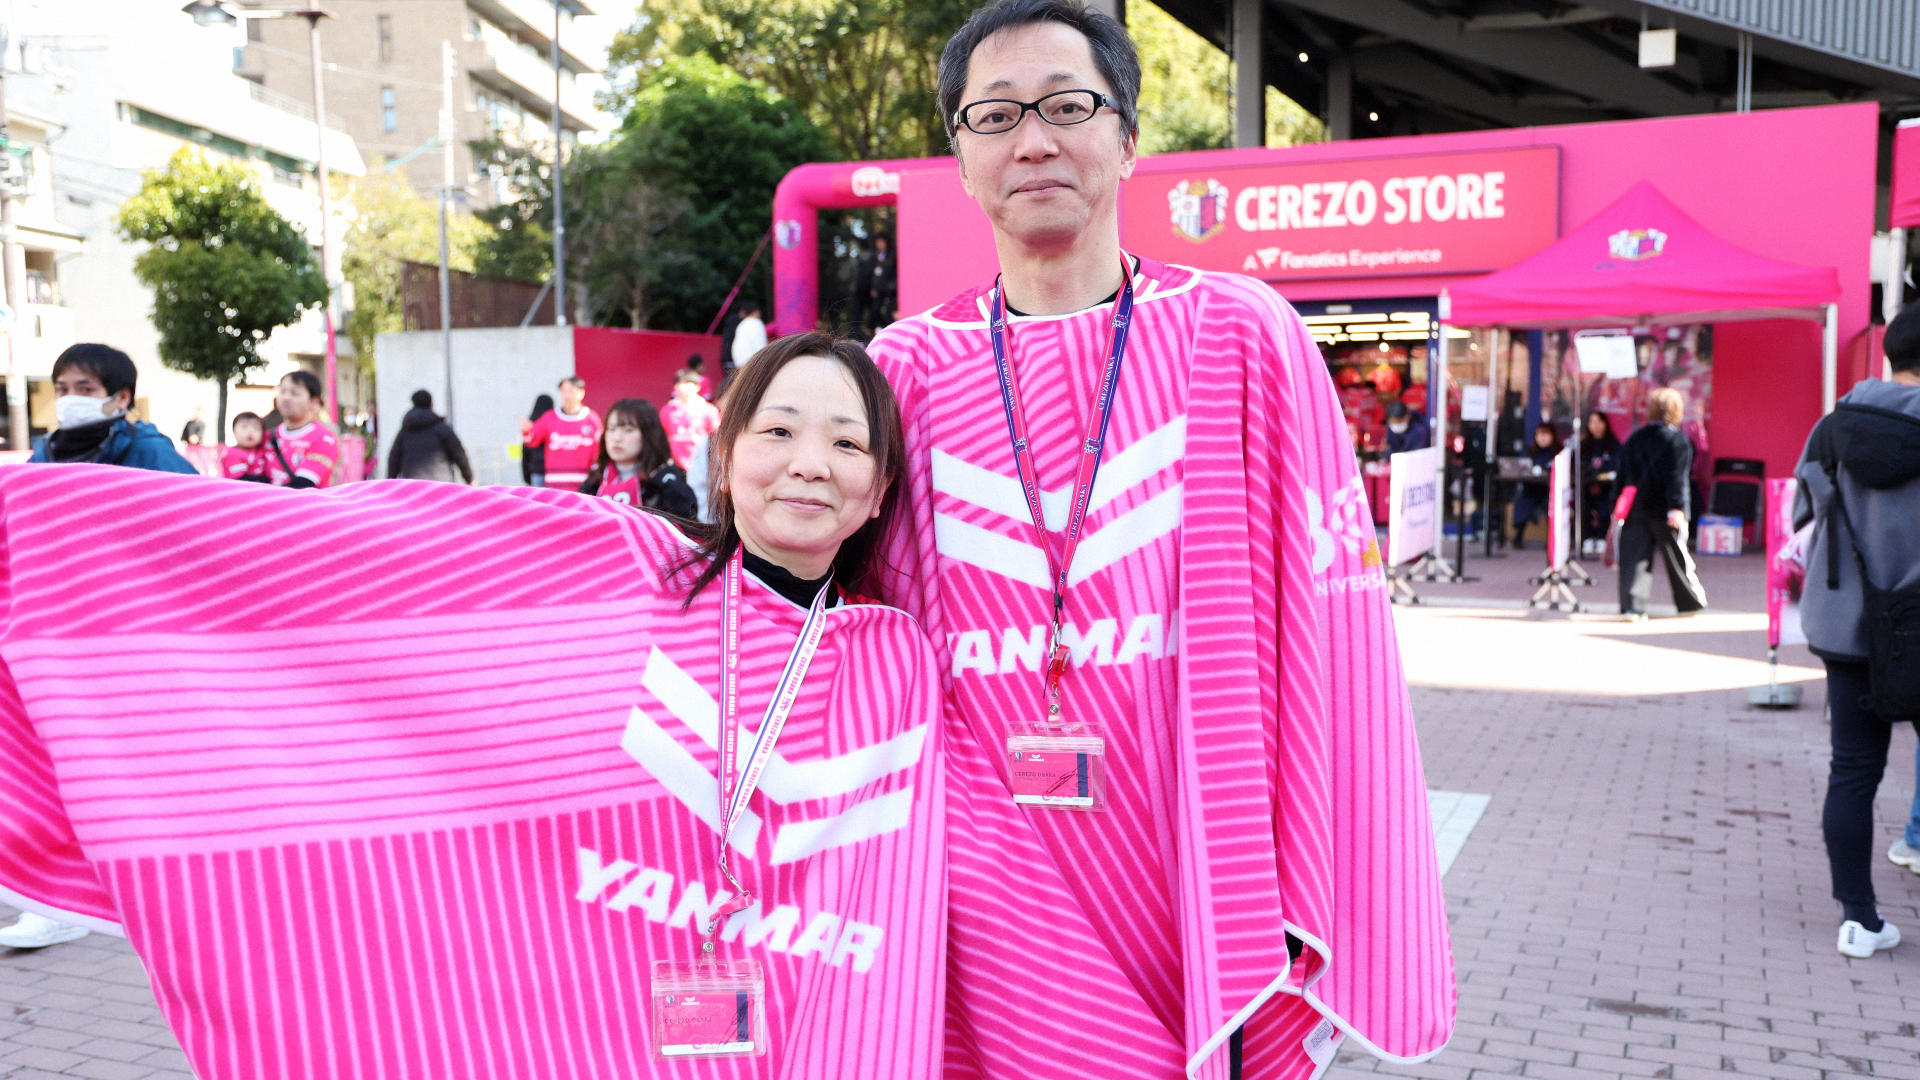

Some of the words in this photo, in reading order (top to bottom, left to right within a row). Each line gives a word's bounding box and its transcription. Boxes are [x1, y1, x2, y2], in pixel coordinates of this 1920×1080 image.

[1235, 180, 1377, 232] CEREZO
[1383, 171, 1505, 224] STORE
[1243, 254, 1259, 271] A
[1280, 249, 1347, 269] Fanatics
[1349, 247, 1443, 270] Experience
[1001, 358, 1010, 386] CEREZO
[1008, 386, 1016, 411] OSAKA
[1098, 381, 1109, 411] CEREZO
[1105, 356, 1116, 381] OSAKA
[1070, 509, 1081, 540] CEREZO
[1078, 483, 1087, 510] OSAKA
[1705, 528, 1736, 551] 13
[730, 559, 738, 578] CEREZO
[730, 578, 738, 597] OSAKA
[729, 609, 737, 630] CEREZO
[729, 631, 737, 651] OSAKA
[808, 628, 820, 645] OSAKA
[796, 656, 808, 677] CEREZO
[728, 673, 736, 695] CEREZO
[786, 676, 799, 695] OSAKA
[728, 695, 736, 716] OSAKA
[770, 715, 782, 736] CEREZO
[727, 730, 735, 752] CEREZO
[761, 735, 774, 754] OSAKA
[726, 753, 734, 774] OSAKA
[746, 766, 760, 787] CEREZO
[739, 787, 751, 807] OSAKA
[575, 846, 884, 974] YANMAR
